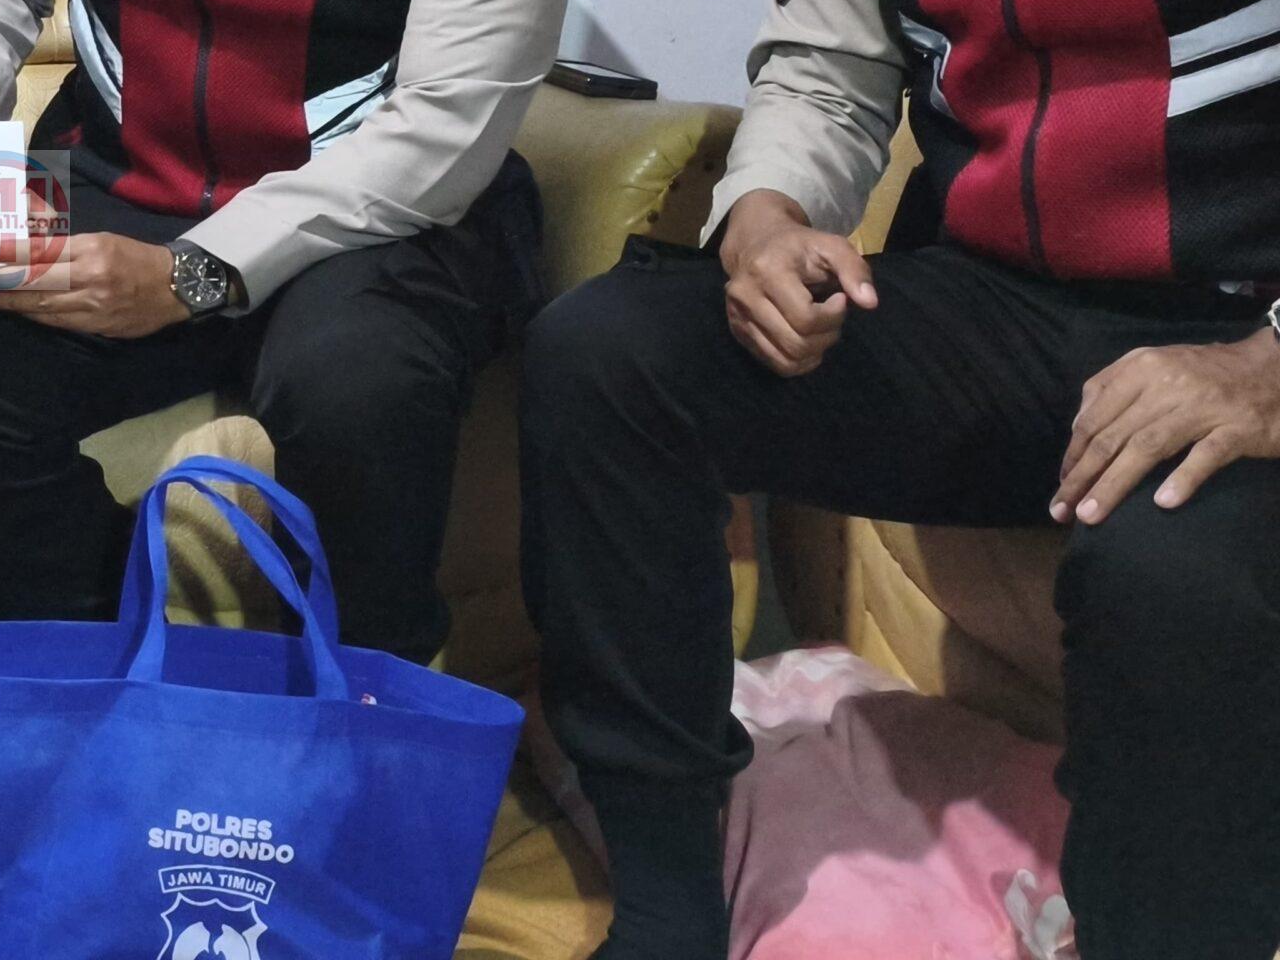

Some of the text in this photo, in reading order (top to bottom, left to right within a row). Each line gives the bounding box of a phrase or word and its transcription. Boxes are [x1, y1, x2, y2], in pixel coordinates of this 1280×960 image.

[176, 809, 272, 840] POLRES
[148, 827, 294, 864] SITUBONDO
[168, 871, 267, 896] JAWA TIMUR
